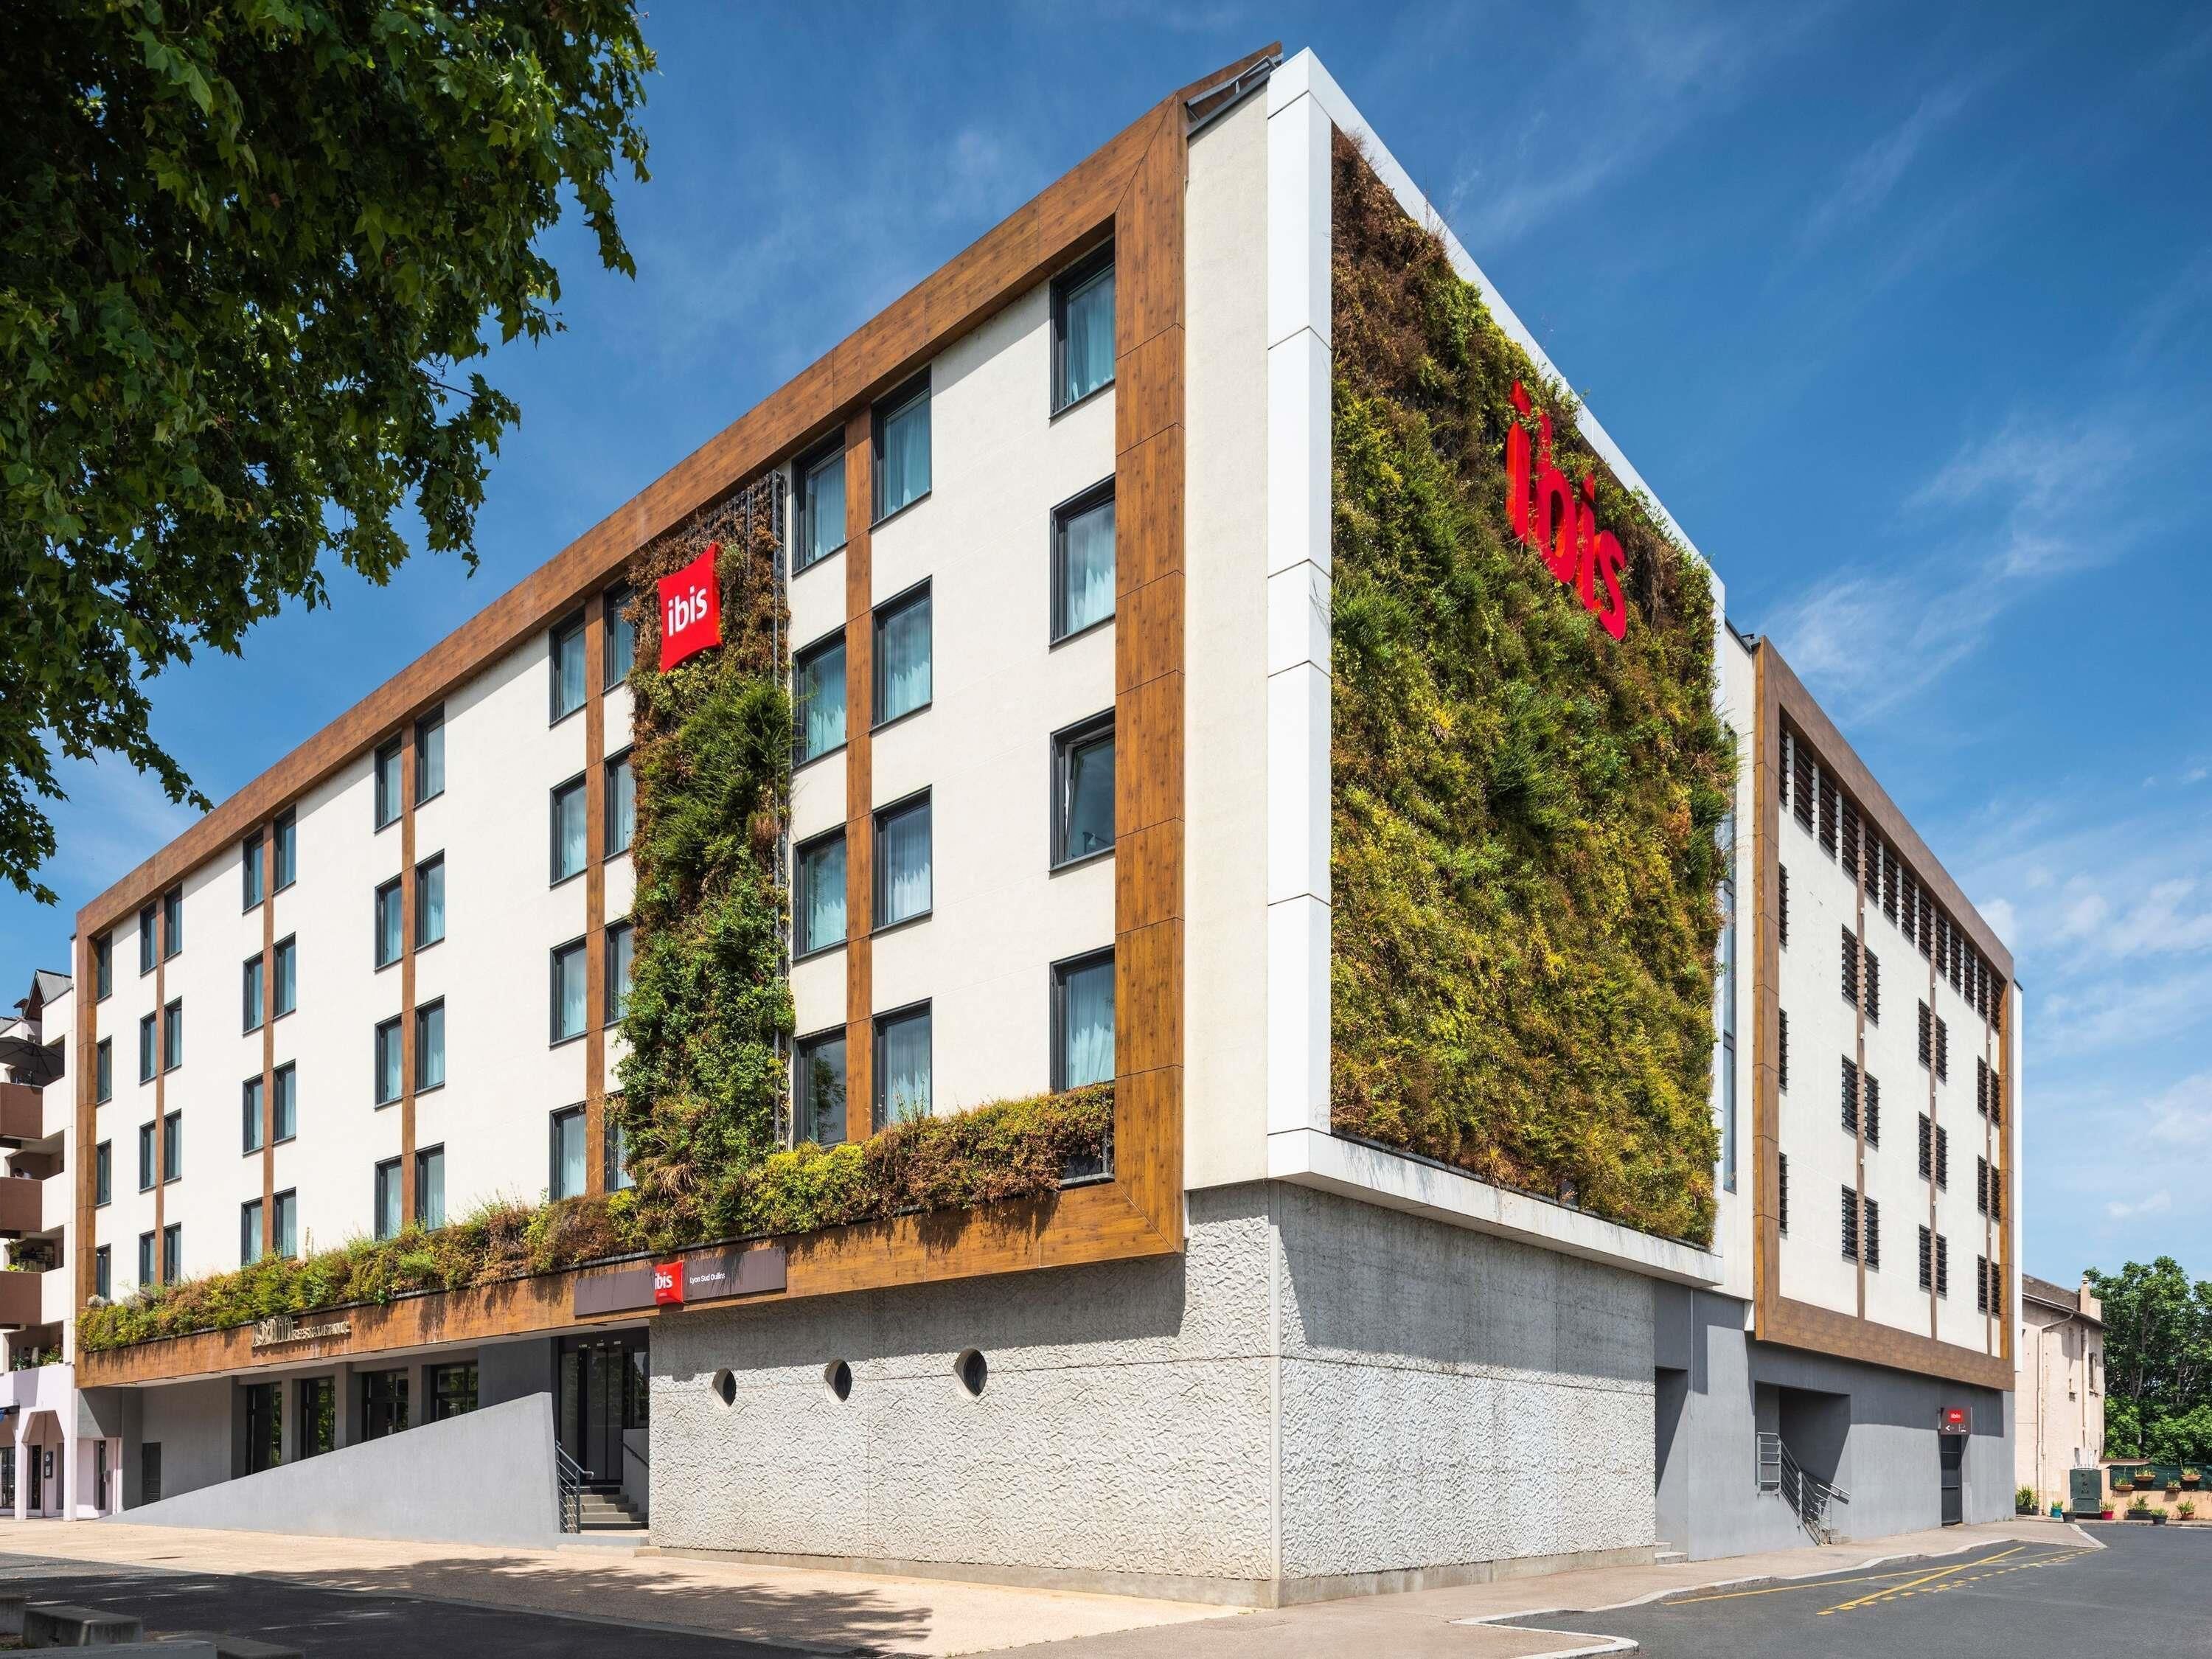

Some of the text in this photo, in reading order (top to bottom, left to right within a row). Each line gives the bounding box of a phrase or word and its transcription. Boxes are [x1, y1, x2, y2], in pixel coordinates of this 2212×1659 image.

[1506, 379, 1627, 641] ibis
[668, 585, 708, 637] ibis
[655, 1271, 672, 1290] ibis
[689, 1276, 700, 1285] Lyon
[700, 1273, 710, 1282] Sud
